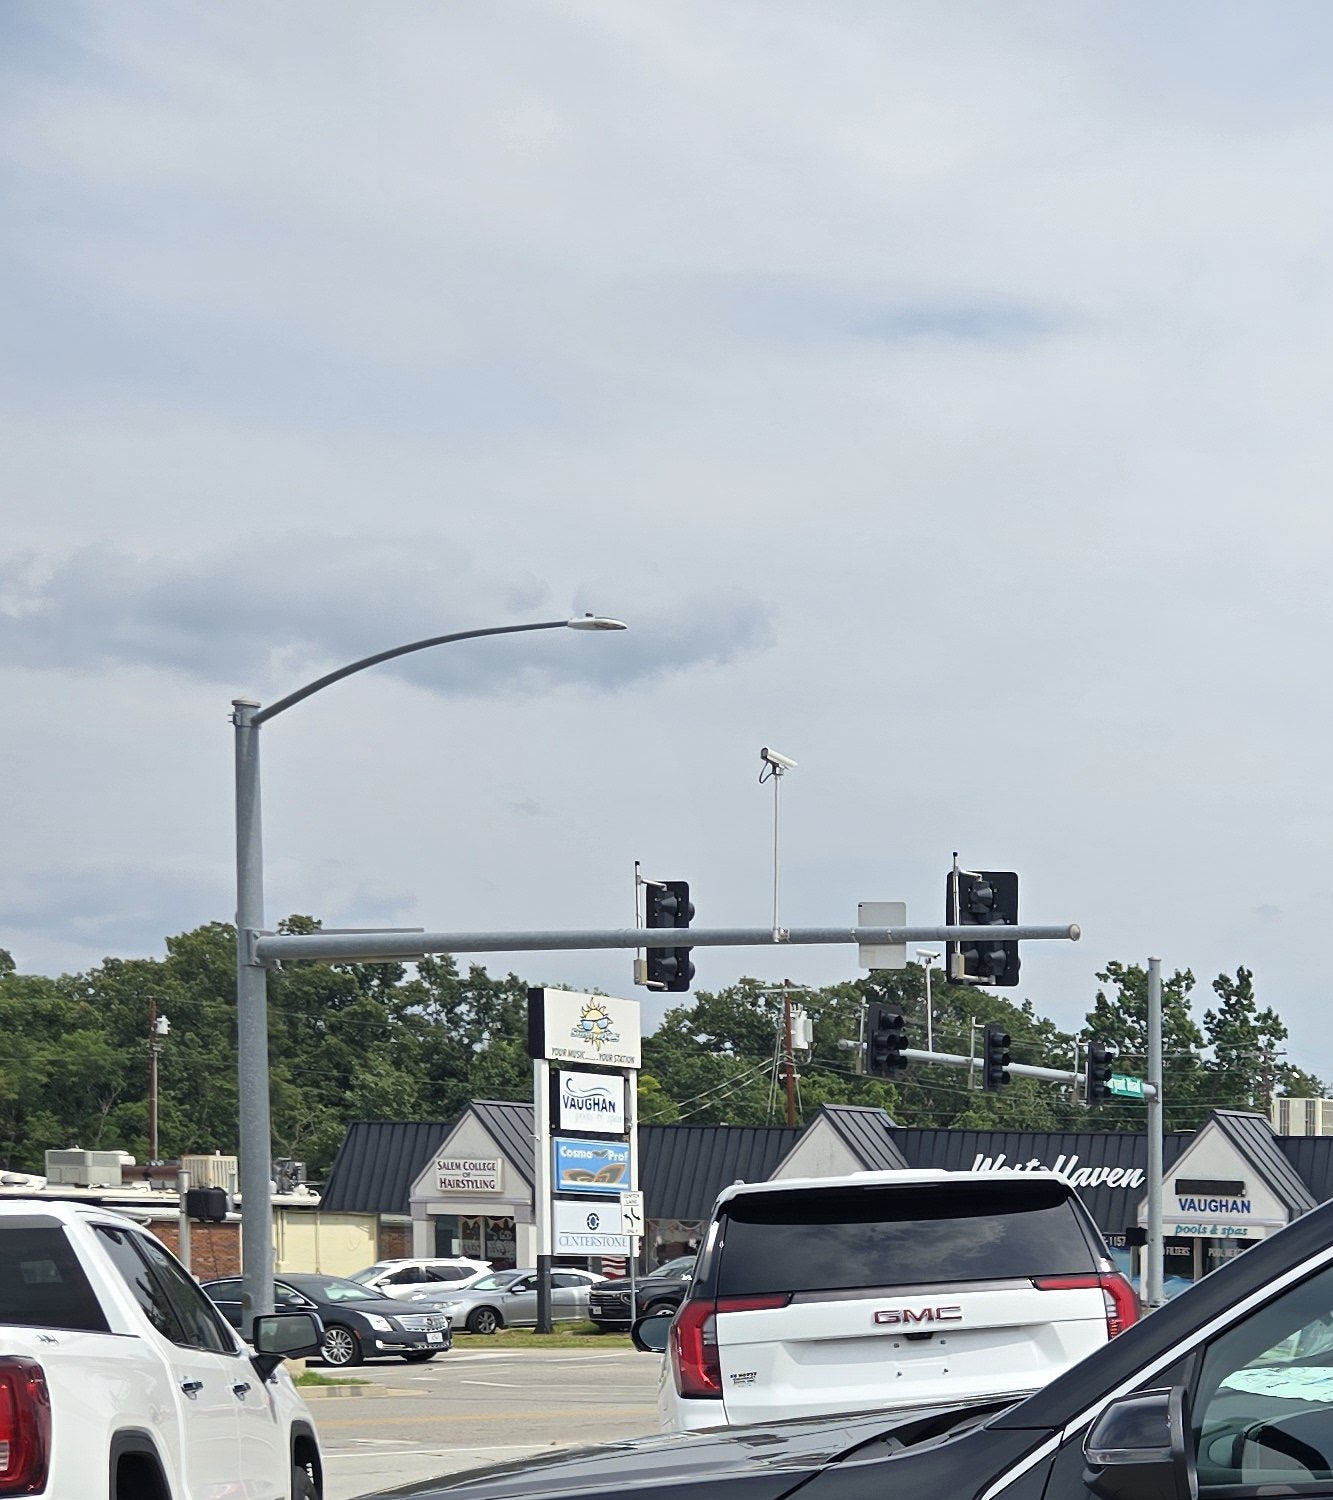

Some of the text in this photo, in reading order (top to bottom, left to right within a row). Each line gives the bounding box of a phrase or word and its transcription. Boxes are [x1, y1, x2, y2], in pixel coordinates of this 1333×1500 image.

[562, 1094, 616, 1113] VAUGHAN
[437, 1160, 496, 1171] SALEM COLLEGE
[1042, 1154, 1146, 1189] Haven
[439, 1177, 496, 1189] HAIRSTYLING
[1178, 1198, 1251, 1214] VAUGHAN
[1175, 1223, 1248, 1237] pools & spas
[559, 1235, 628, 1248] CENTERSTONE
[1166, 1246, 1191, 1256] FILTERS
[874, 1306, 962, 1324] GMC
